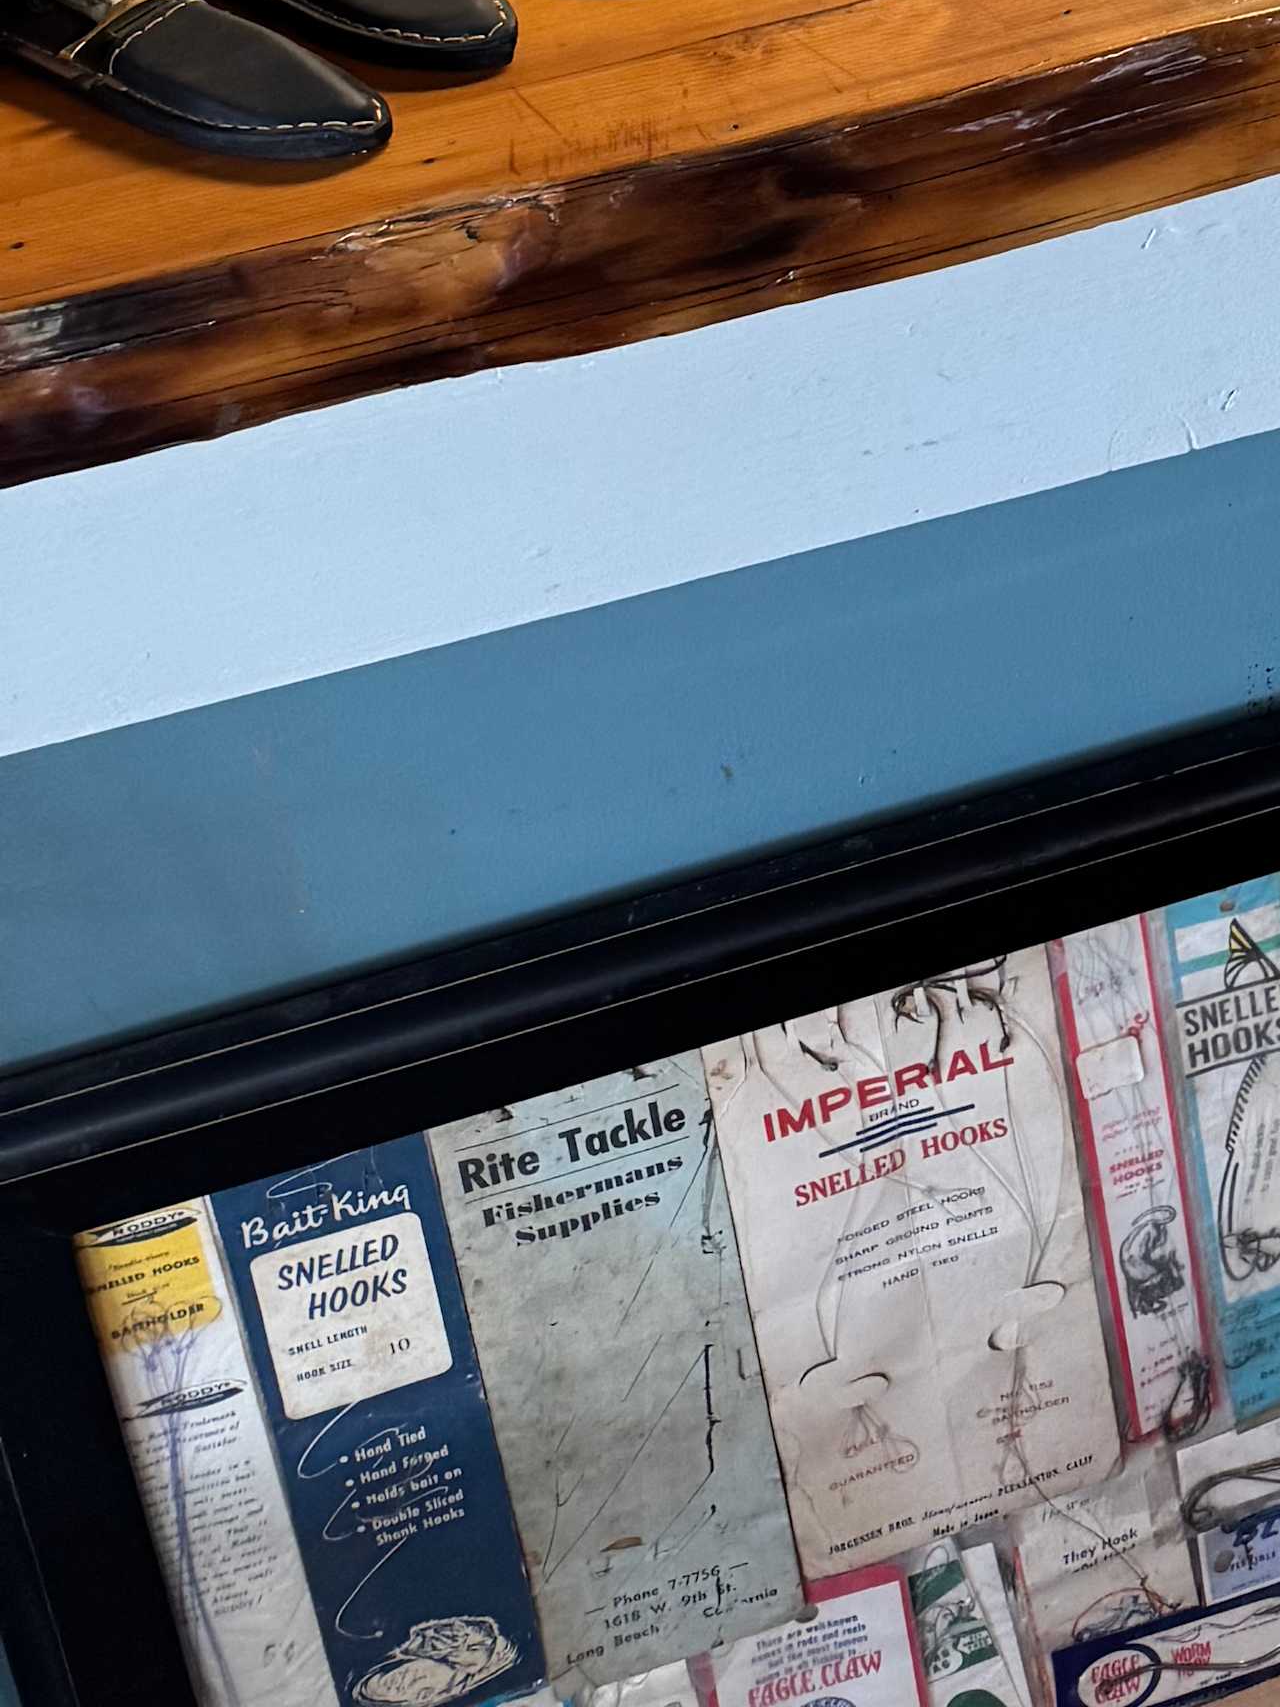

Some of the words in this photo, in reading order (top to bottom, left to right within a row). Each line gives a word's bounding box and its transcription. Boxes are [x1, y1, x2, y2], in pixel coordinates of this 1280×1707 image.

[762, 1039, 1014, 1142] IMPERIAL
[457, 1151, 540, 1194] Rite
[559, 1101, 686, 1163] Tackle
[794, 1149, 906, 1207] SNELLED
[921, 1118, 1008, 1159] HOOKS
[482, 1156, 683, 1227] Fishermans
[515, 1191, 661, 1246] Supplies
[278, 1233, 399, 1291] SNELLED
[308, 1268, 408, 1320] HOOKS
[355, 1438, 392, 1461] Hand
[398, 1426, 426, 1447] Tied
[360, 1463, 397, 1484] Hand
[402, 1445, 449, 1469] Forged
[444, 1467, 462, 1481] on
[372, 1506, 420, 1530] Double
[425, 1490, 464, 1513] Sliced
[1064, 1547, 1096, 1565] They
[1102, 1528, 1138, 1549] Hook
[613, 1587, 659, 1608] Phone
[819, 1650, 882, 1686] CLAW
